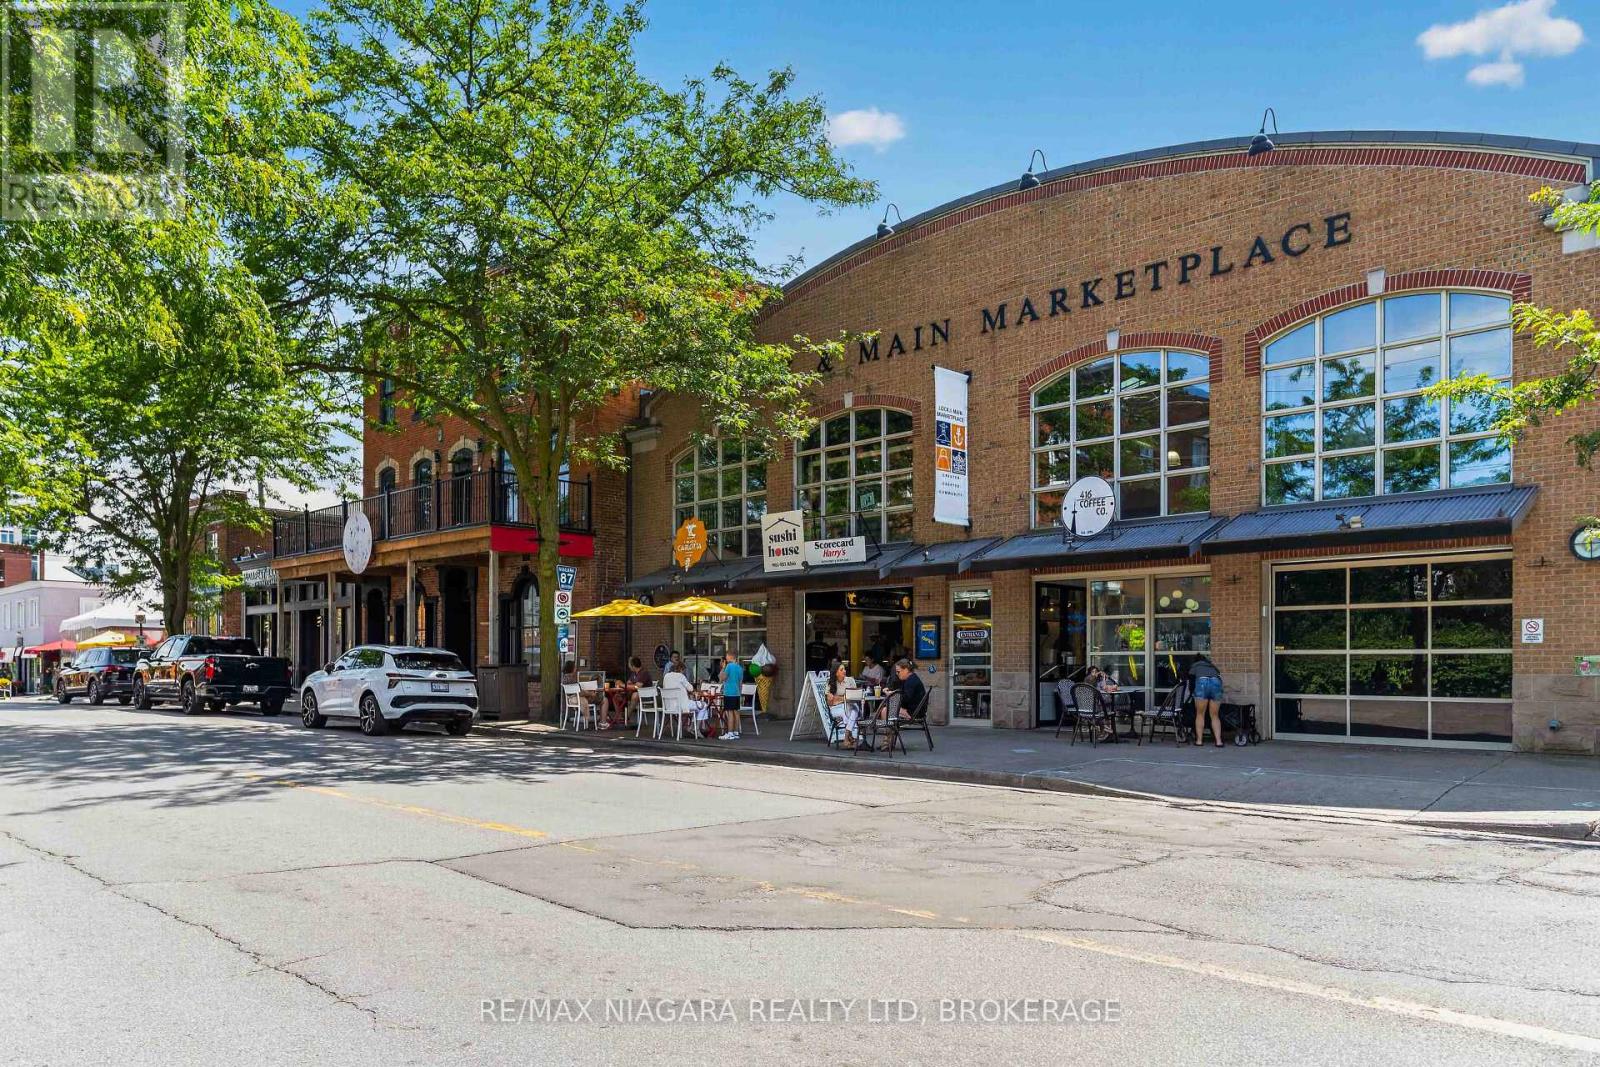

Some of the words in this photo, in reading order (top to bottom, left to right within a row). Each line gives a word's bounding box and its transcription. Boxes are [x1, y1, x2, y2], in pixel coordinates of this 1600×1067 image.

[858, 318, 950, 364] MAIN
[981, 212, 1352, 333] MARKETPLACE
[1079, 489, 1092, 499] 416
[1079, 498, 1106, 508] COFFEE
[1096, 507, 1108, 516] CO.
[768, 528, 797, 544] sushi
[814, 538, 854, 550] Scorecard
[767, 545, 800, 558] house
[822, 548, 846, 559] Harry's
[560, 573, 573, 584] 87
